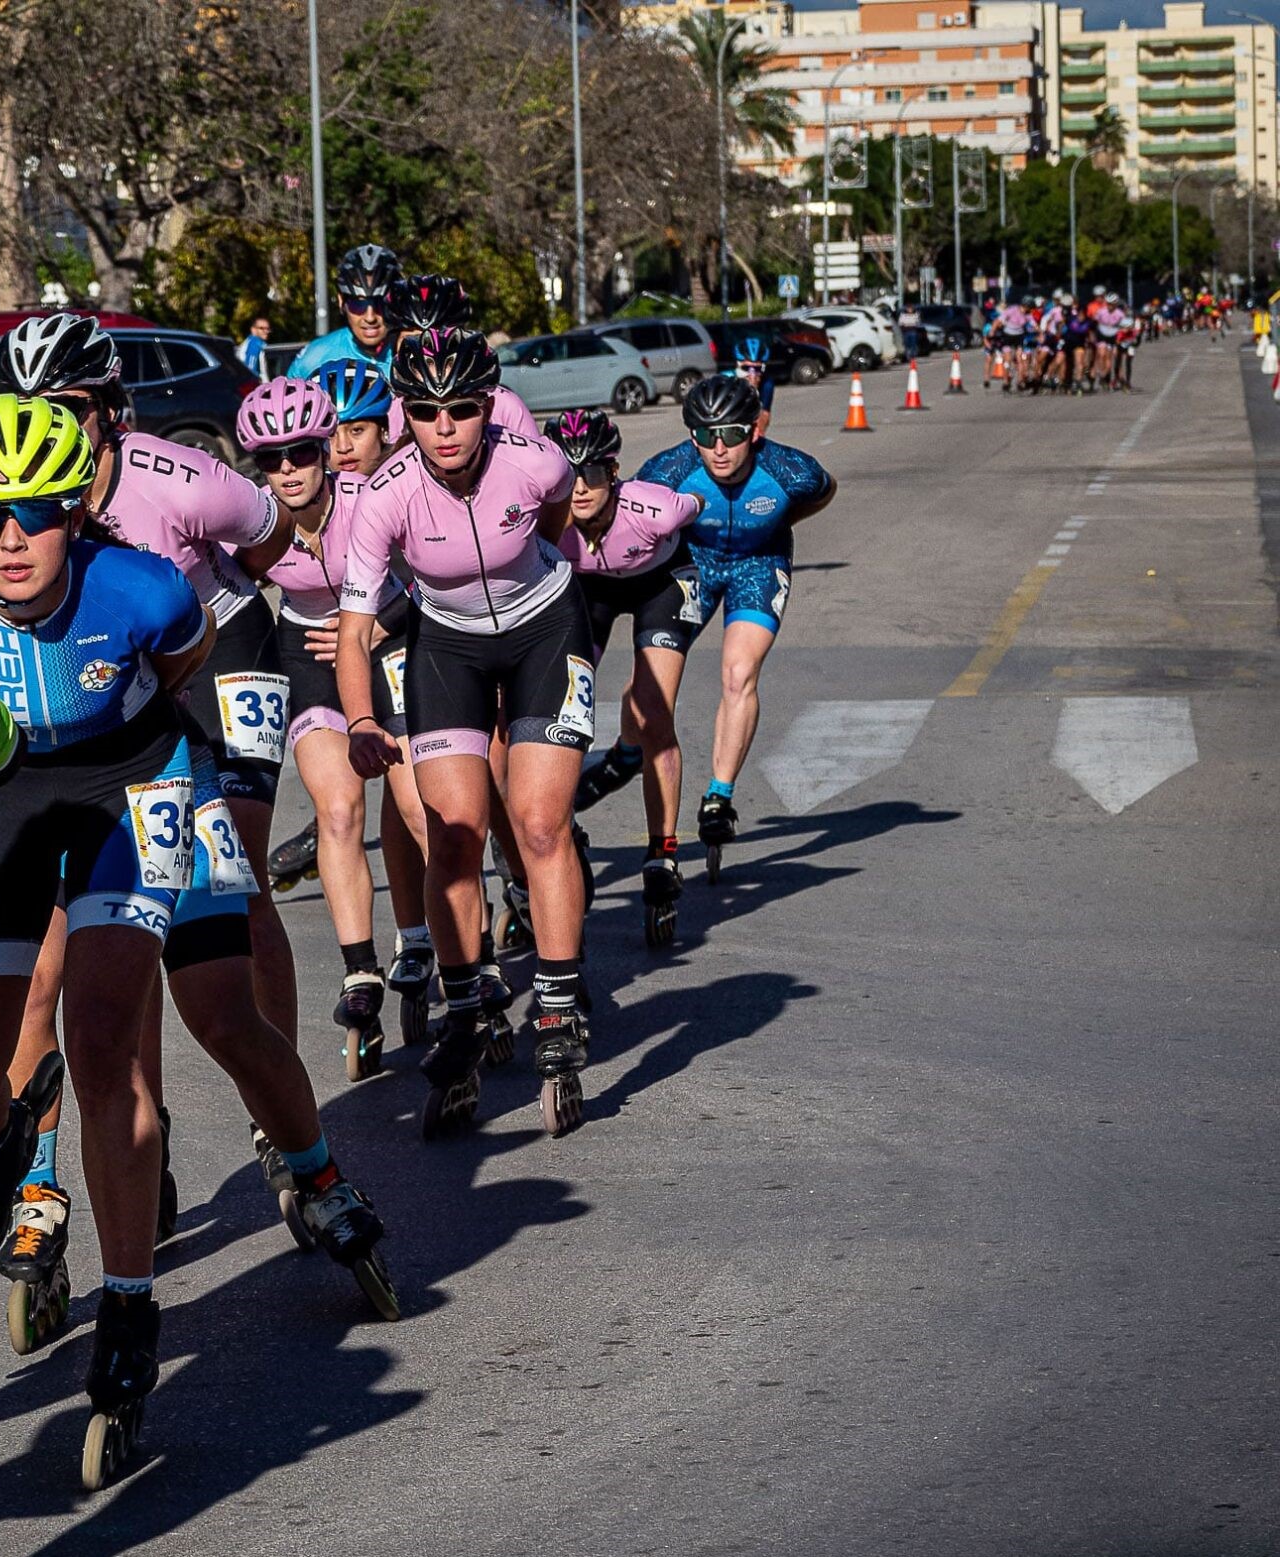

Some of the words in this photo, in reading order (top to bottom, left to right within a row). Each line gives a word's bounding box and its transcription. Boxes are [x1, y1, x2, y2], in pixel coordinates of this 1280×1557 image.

[129, 448, 200, 484] CDT
[370, 446, 419, 491] CDT
[235, 689, 287, 732] 33
